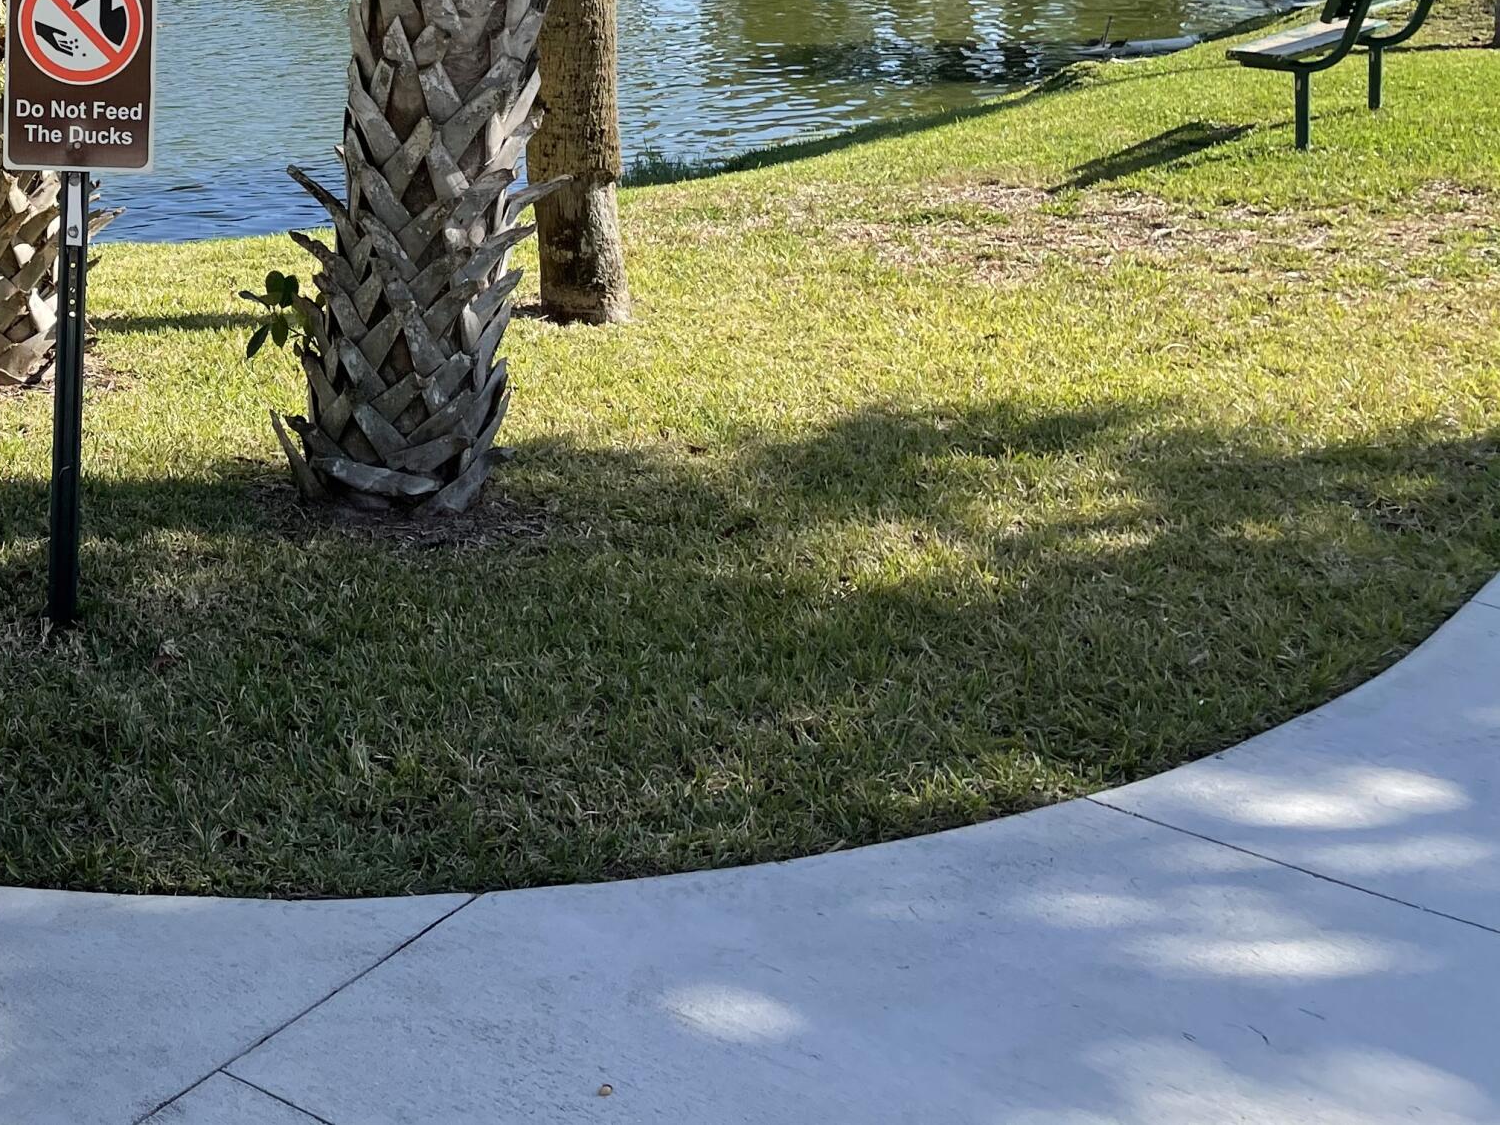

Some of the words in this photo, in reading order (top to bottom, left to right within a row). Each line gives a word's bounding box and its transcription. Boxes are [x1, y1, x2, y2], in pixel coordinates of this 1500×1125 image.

[16, 99, 44, 118] Do
[50, 100, 87, 119] Not
[92, 101, 143, 121] Feed
[24, 124, 62, 143] The
[68, 125, 133, 145] Ducks
